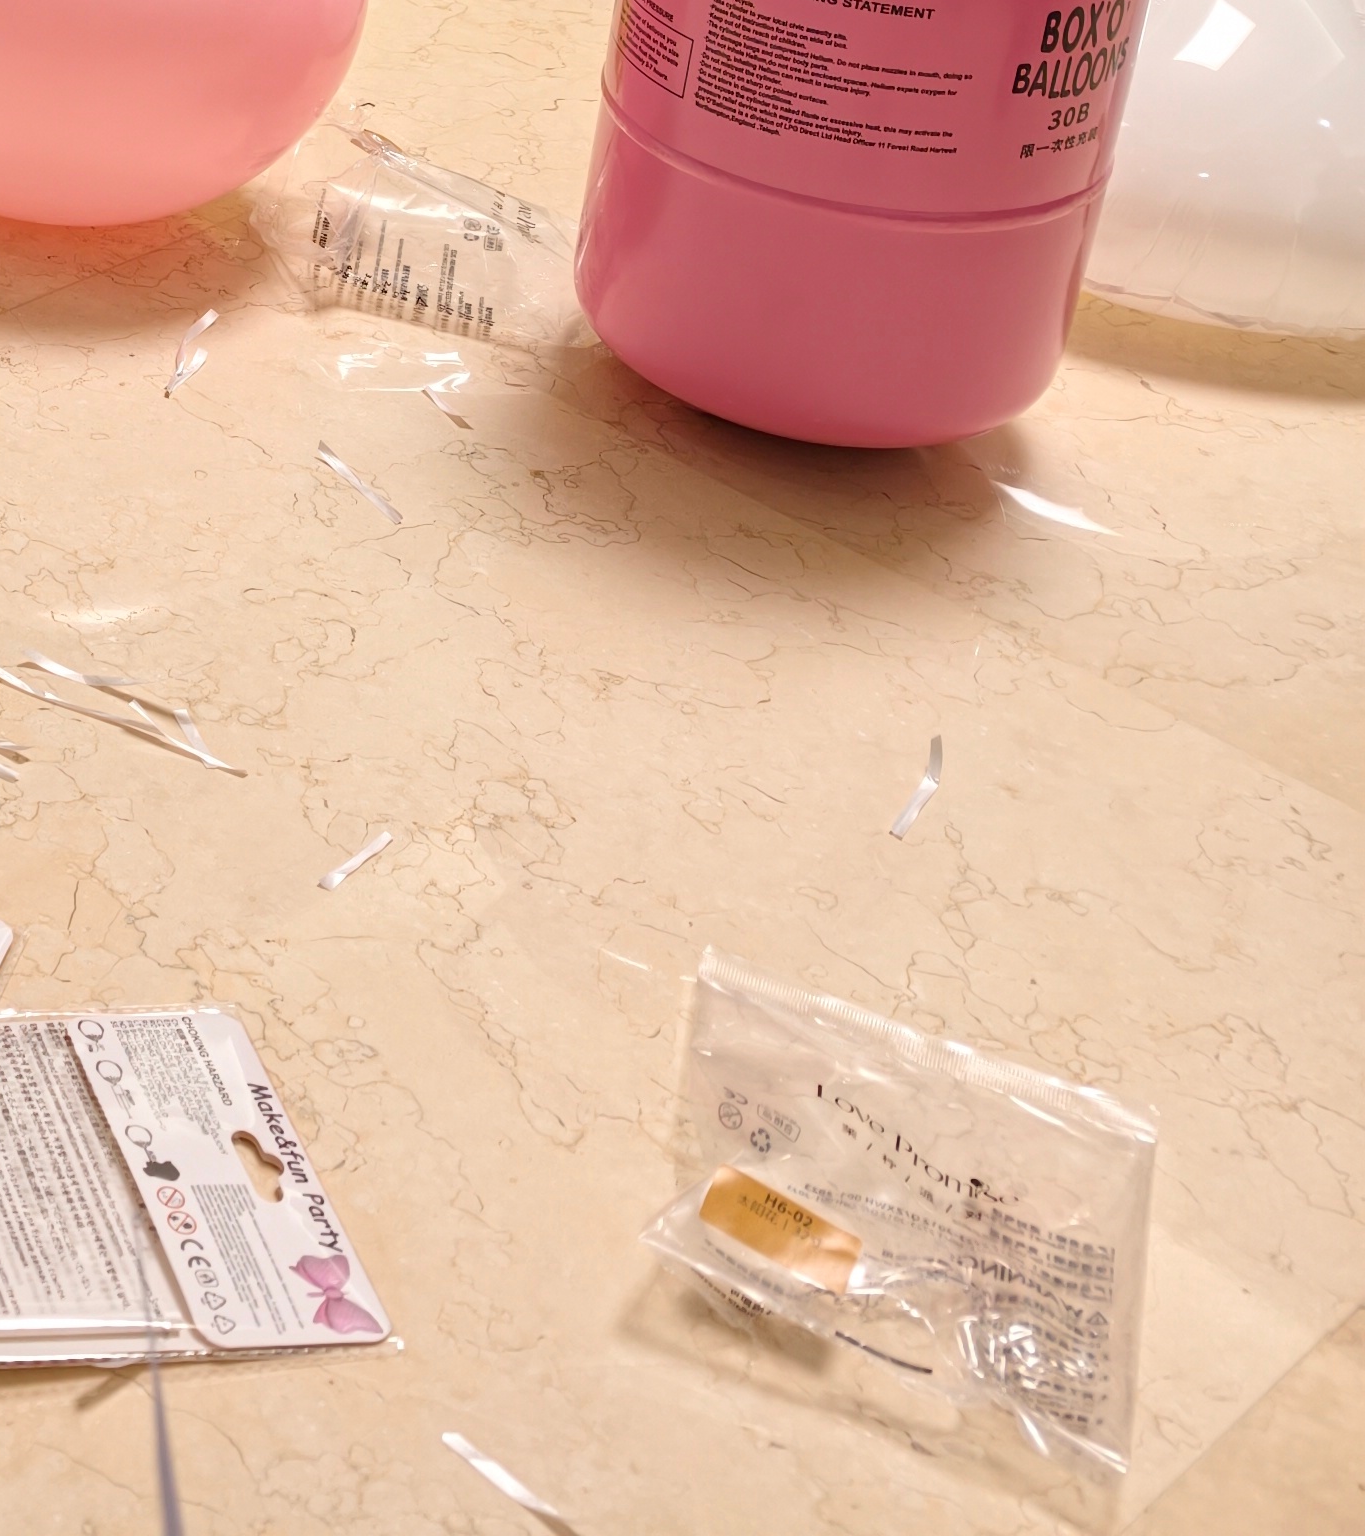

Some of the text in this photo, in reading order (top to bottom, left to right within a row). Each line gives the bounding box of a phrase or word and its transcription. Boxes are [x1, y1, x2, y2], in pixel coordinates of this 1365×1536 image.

[1012, 37, 1130, 99] BALLOONS
[1047, 102, 1090, 131] 30B
[182, 1016, 233, 1107] CHOKING HARZARD
[247, 1082, 308, 1184] Make&fun
[303, 1192, 343, 1254] Party
[764, 1193, 814, 1227] H6-02
